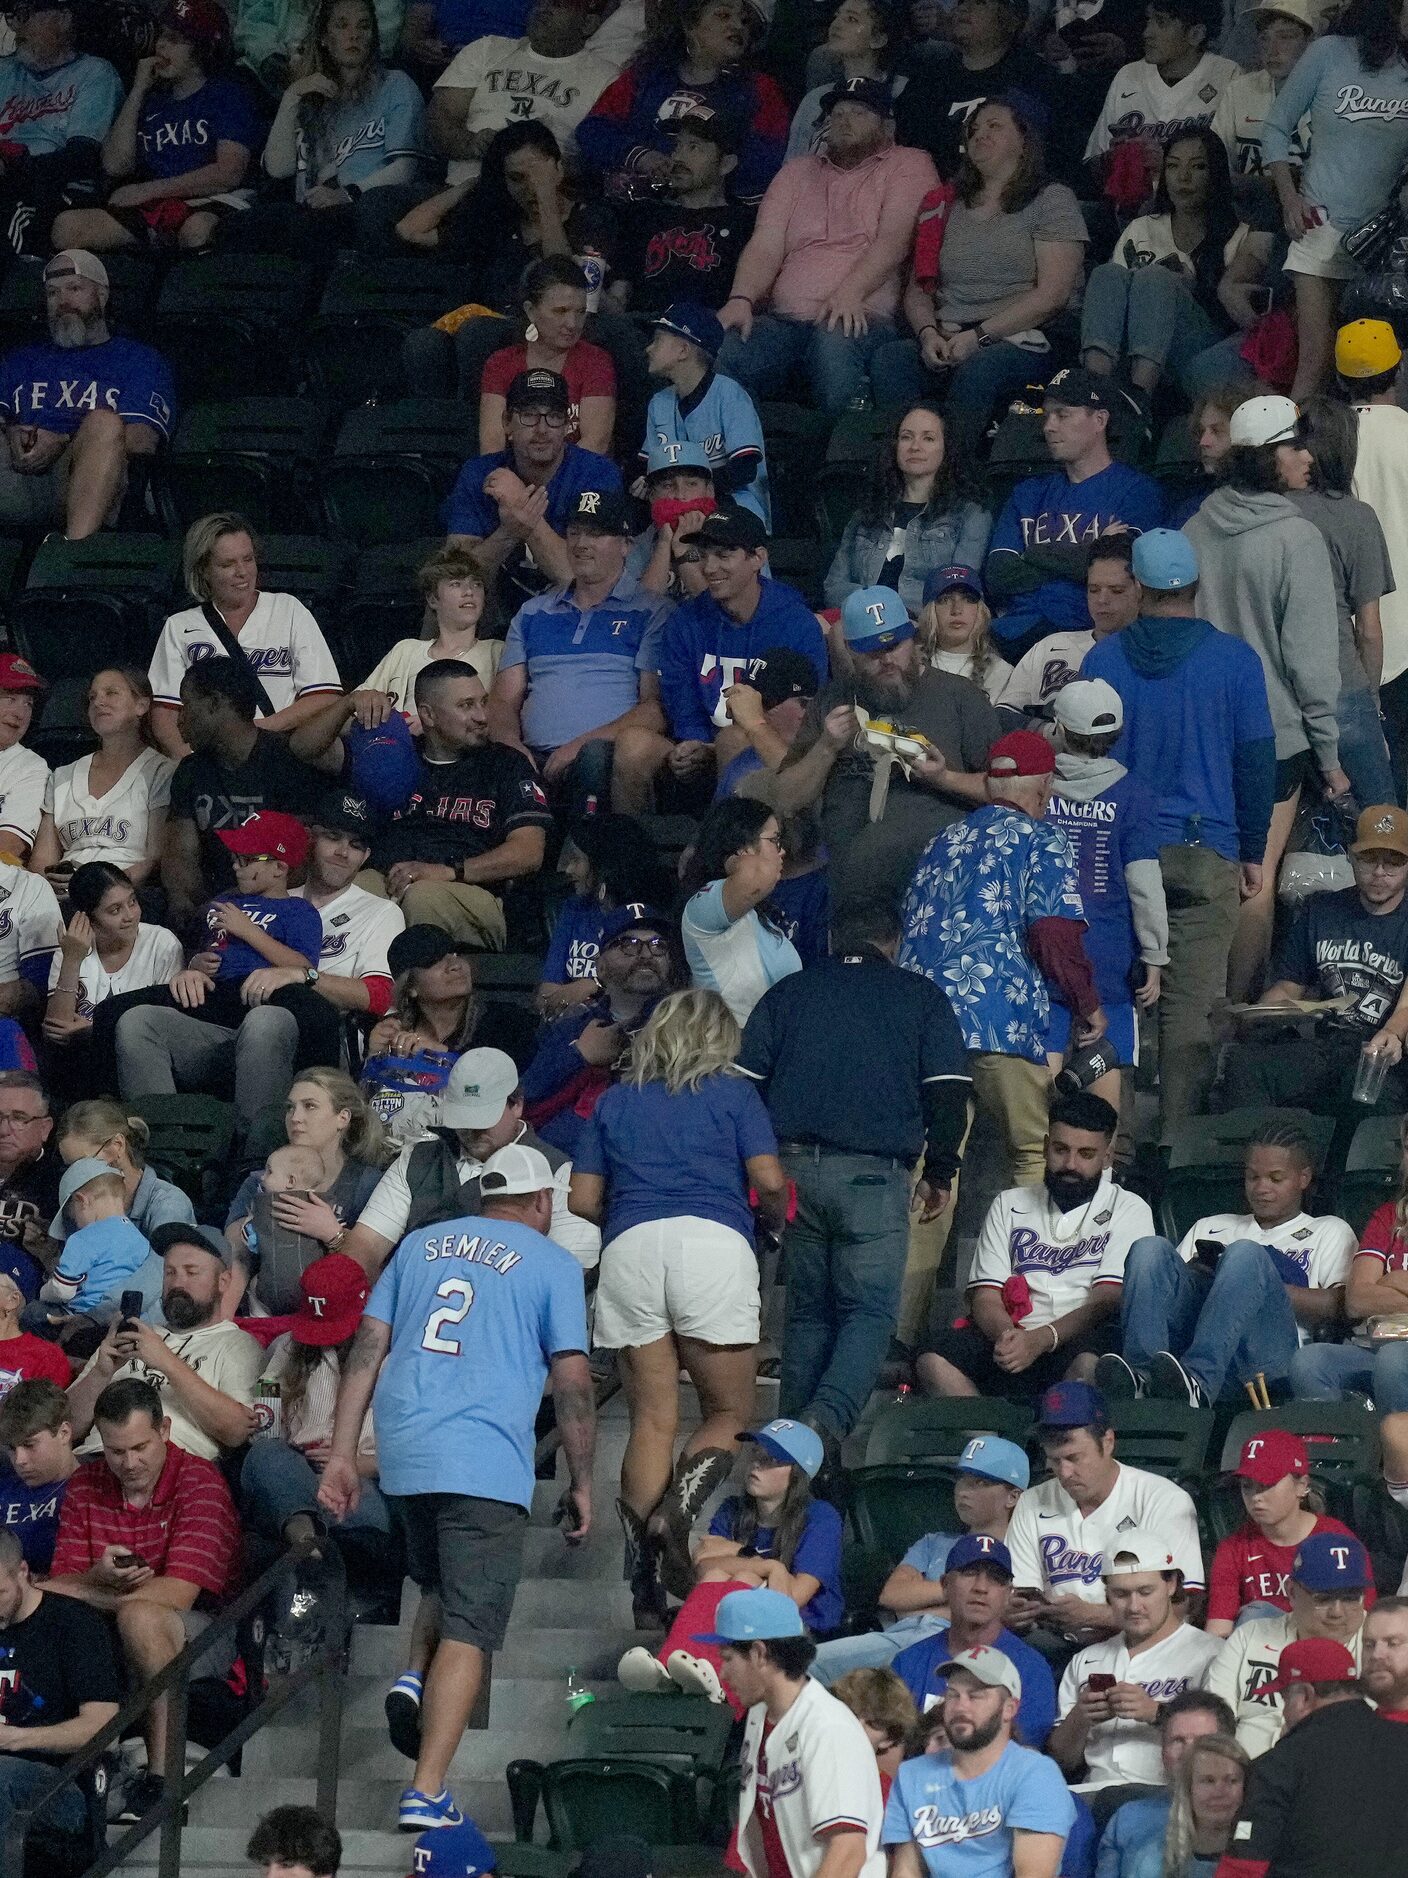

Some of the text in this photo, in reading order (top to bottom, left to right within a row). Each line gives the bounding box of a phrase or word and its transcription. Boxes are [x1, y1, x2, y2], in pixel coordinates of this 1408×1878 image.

[486, 69, 582, 109] TEXAS
[137, 119, 208, 152] TEXAS
[664, 444, 683, 462] T
[865, 602, 886, 627] T
[612, 620, 628, 635] T
[626, 902, 645, 921] T
[1317, 939, 1359, 962] World
[423, 1234, 523, 1275] SEMIEN
[1012, 1228, 1112, 1275] Rangers
[308, 1296, 328, 1317] T
[422, 1276, 475, 1357] 2
[966, 1440, 985, 1460] T
[1247, 1440, 1265, 1459] T
[976, 1536, 996, 1553] T
[1330, 1547, 1350, 1570] T
[912, 1805, 1002, 1848] Rangers
[413, 1845, 432, 1872] T
